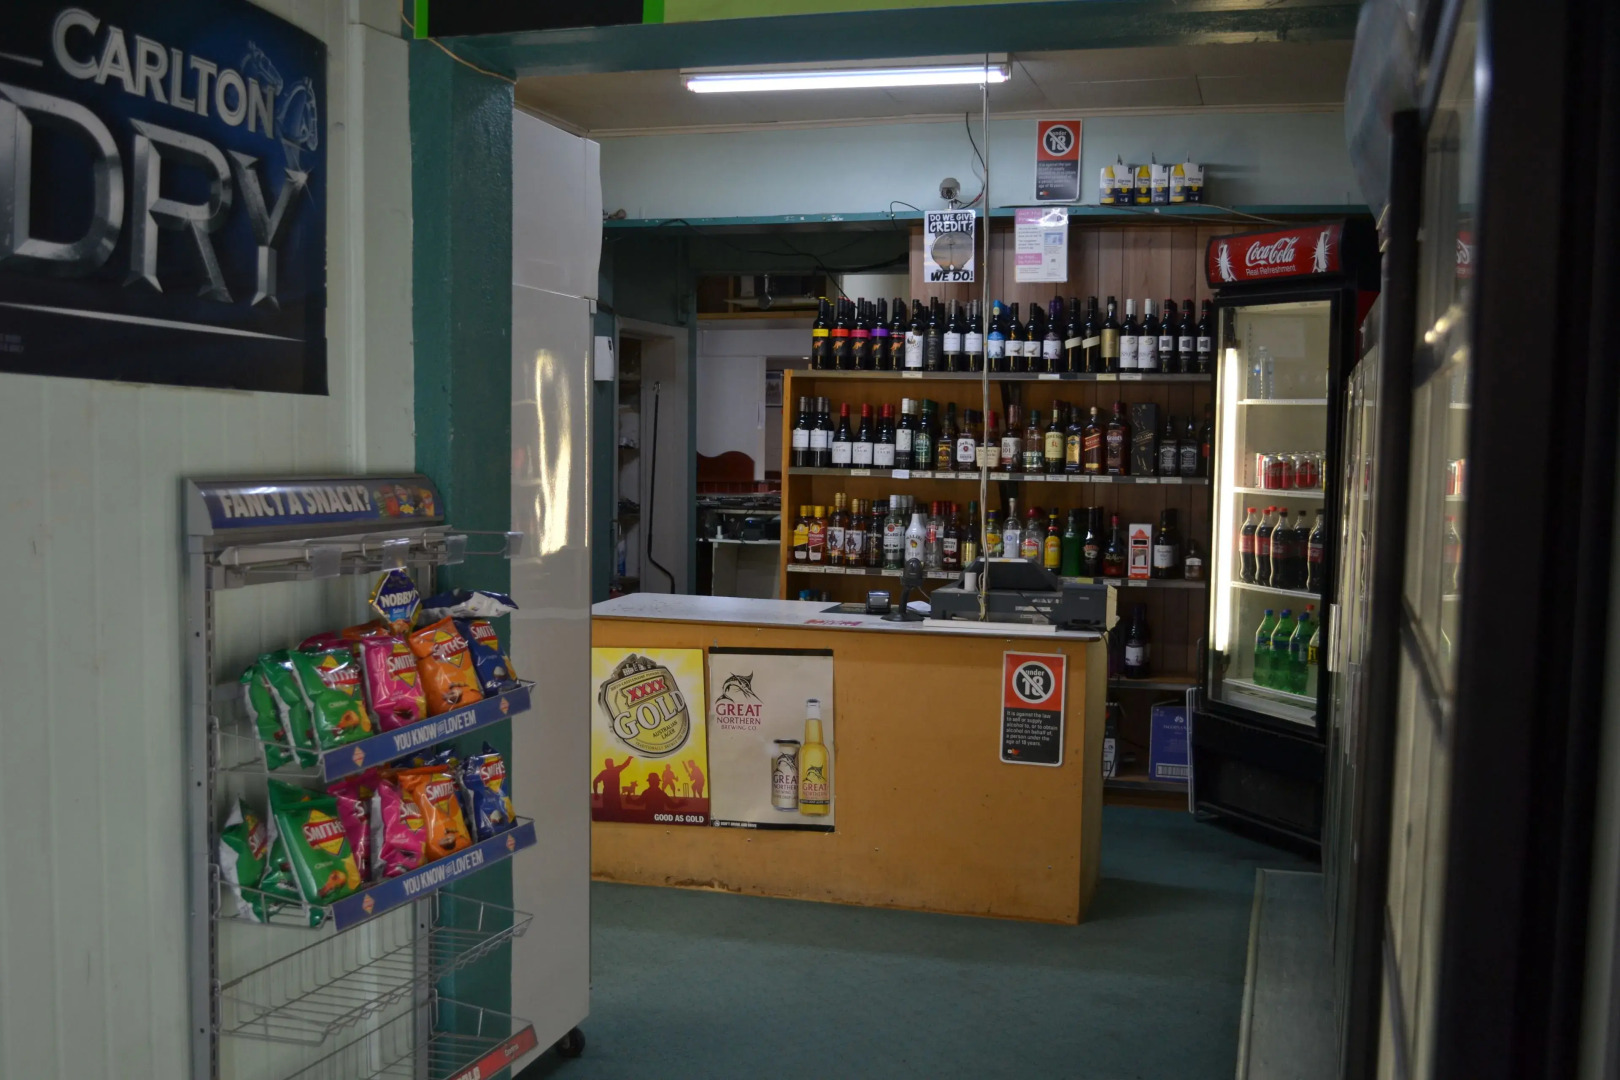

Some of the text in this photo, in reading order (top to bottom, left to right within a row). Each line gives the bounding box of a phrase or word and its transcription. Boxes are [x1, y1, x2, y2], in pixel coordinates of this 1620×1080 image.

[51, 8, 275, 139] CARLTON
[0, 82, 308, 312] DRY
[930, 214, 940, 222] DO
[942, 213, 955, 221] WE
[930, 220, 973, 232] CREDIT?
[1245, 237, 1300, 266] Coca-Cola
[931, 271, 973, 281] WE DO!
[1246, 264, 1296, 276] Real Refreshment
[217, 485, 371, 518] FANCY A SNACK?
[627, 679, 665, 702] XXXX
[1022, 676, 1044, 696] 18
[613, 690, 686, 739] GOLD
[716, 703, 762, 717] GREAT
[652, 720, 678, 738] AUSTRALIAN
[716, 717, 761, 725] NORTHERN
[393, 732, 411, 751] YOU
[410, 723, 437, 745] KNOW
[443, 713, 464, 734] LOVE
[661, 729, 676, 740] LAGER
[802, 783, 828, 791] GREAT
[654, 813, 704, 823] GOOD AS GOLD
[402, 877, 420, 896] YOU
[420, 864, 445, 888] KNOW
[451, 855, 472, 875] LOVE
